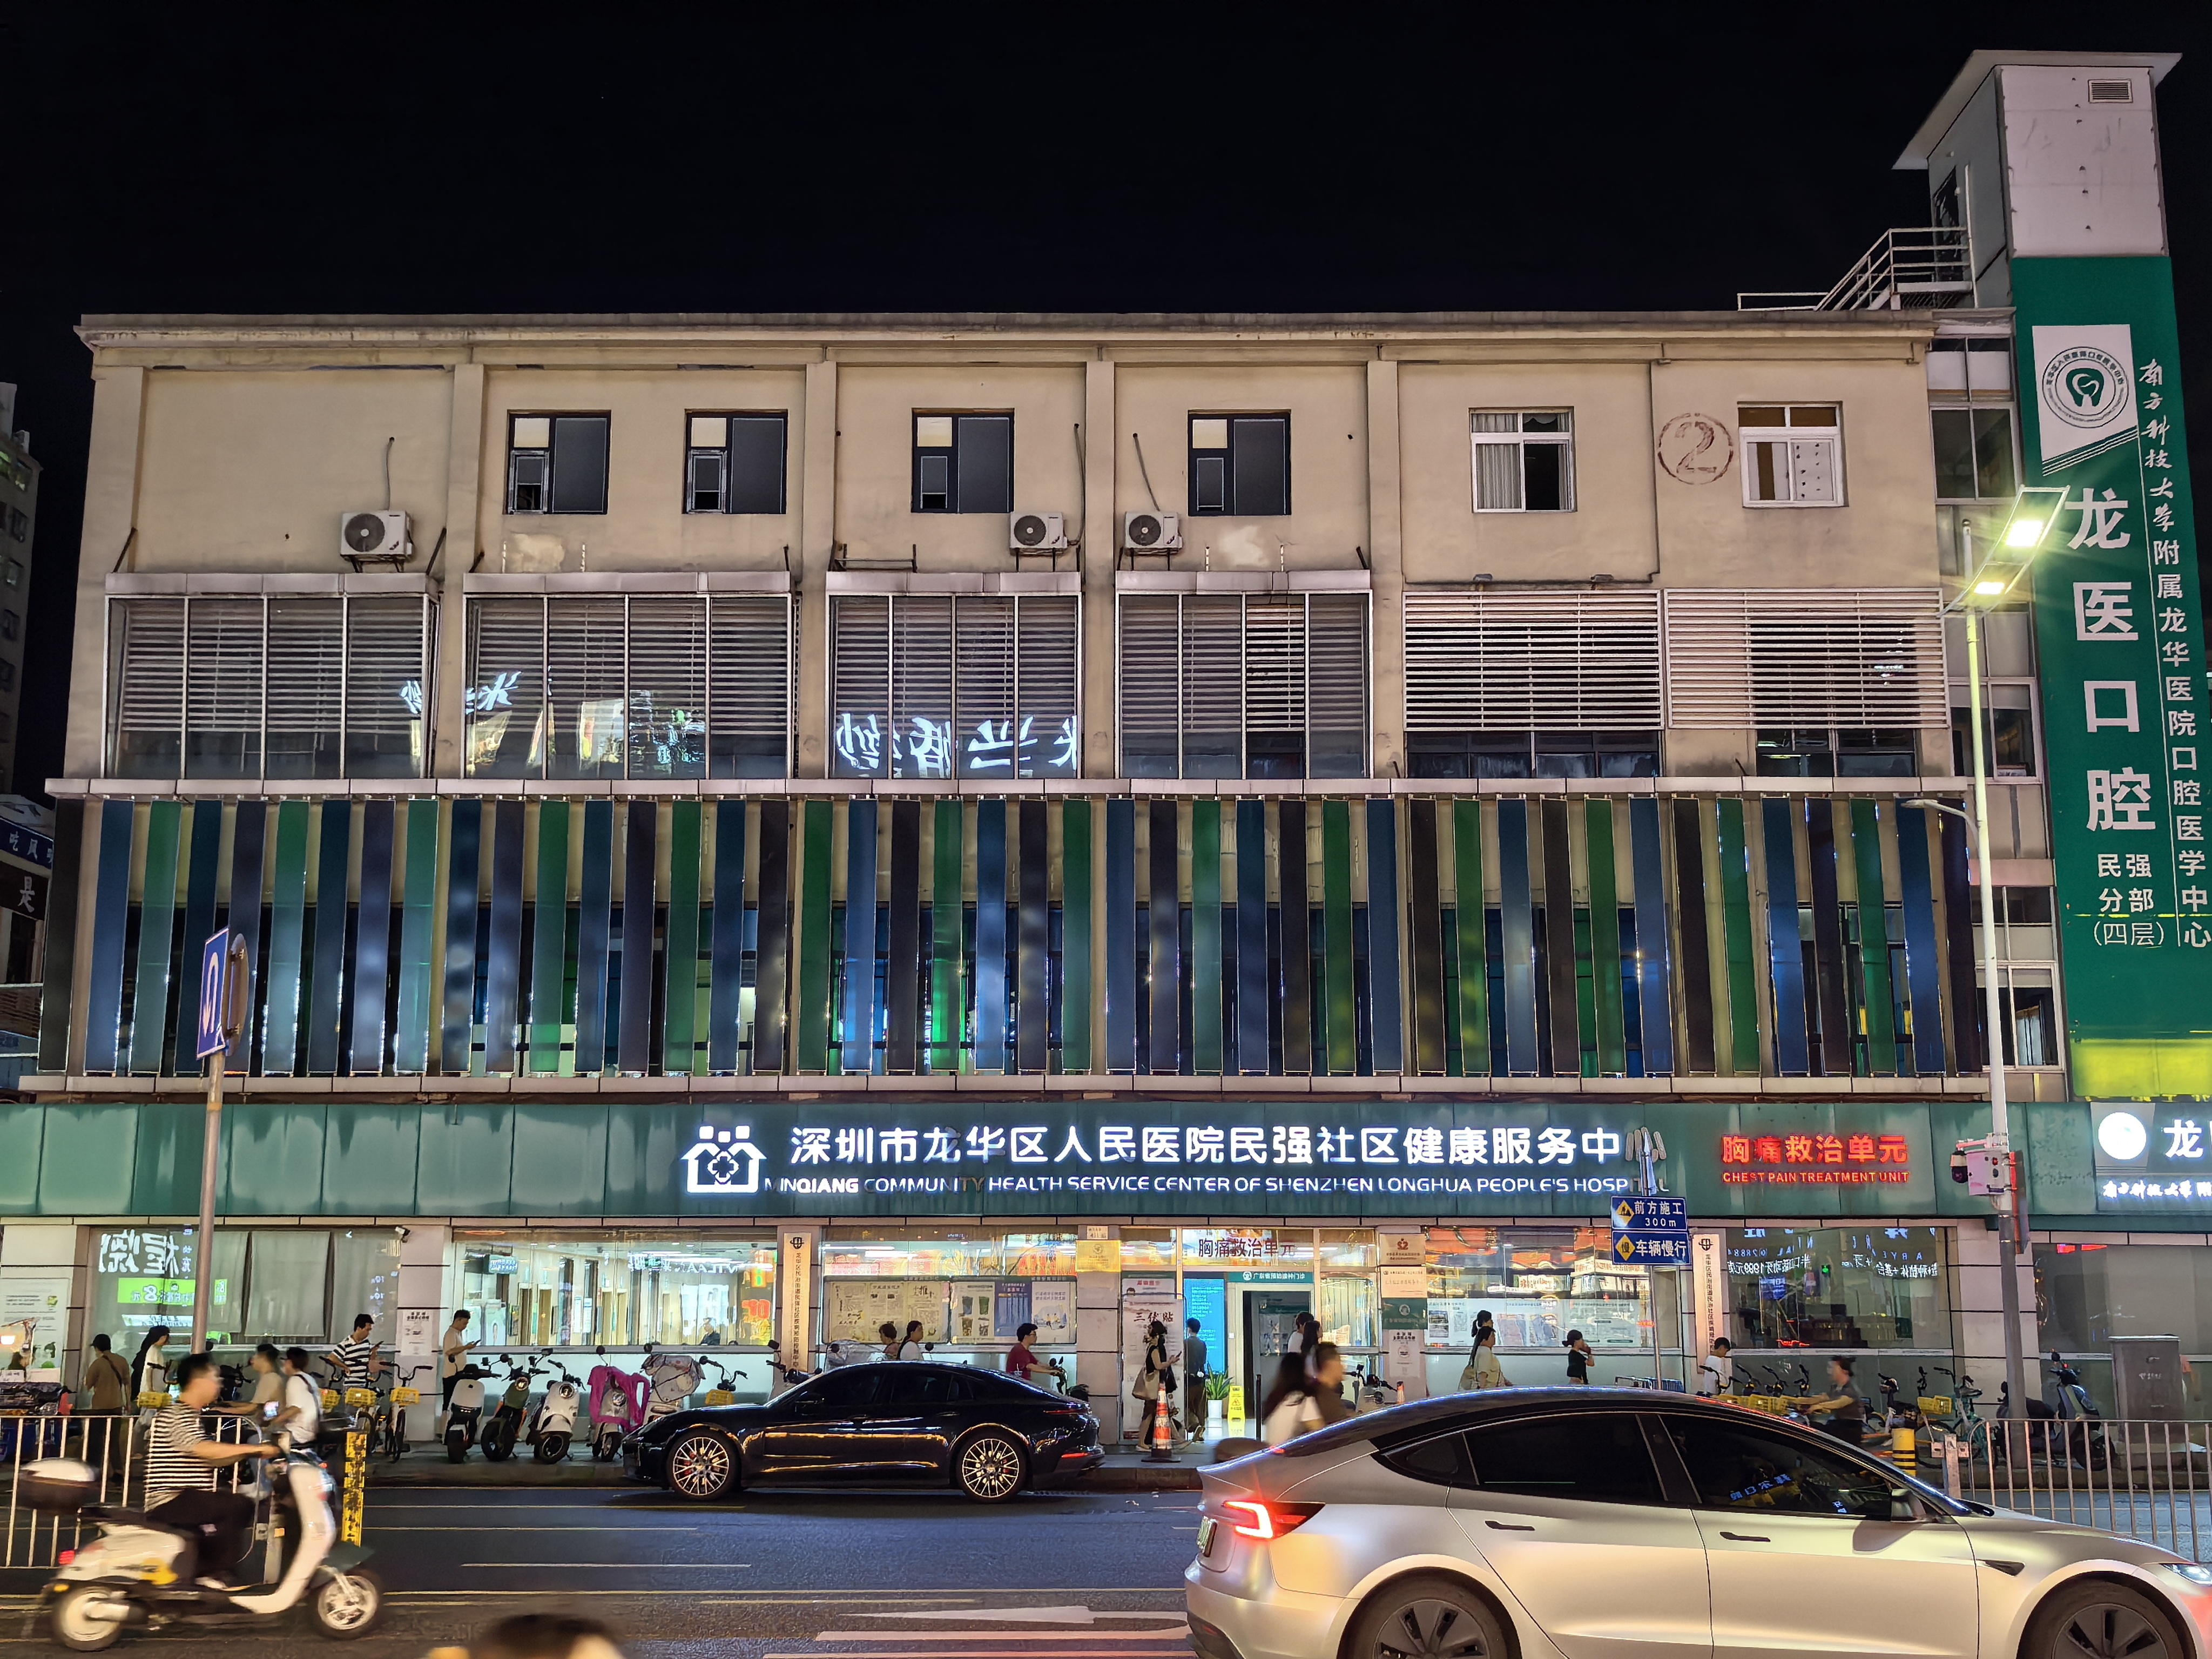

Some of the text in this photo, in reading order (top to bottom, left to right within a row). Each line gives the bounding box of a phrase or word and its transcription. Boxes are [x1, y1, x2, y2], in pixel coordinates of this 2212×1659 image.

[2065, 488, 2156, 832] 龙医口腔
[2098, 853, 2153, 879] 民强
[2099, 888, 2154, 913] 分部
[1722, 1135, 1908, 1163] 胸痛救治单元
[864, 1177, 985, 1193] COMMUNITY
[989, 1177, 1062, 1192] HEALTH
[1067, 1176, 1150, 1191] SERVICE
[1154, 1177, 1230, 1191] CENTER
[1234, 1177, 1261, 1192] OF
[1265, 1177, 1373, 1192] SHENZHEN
[1378, 1177, 1473, 1192] LONGHUA
[1476, 1178, 1568, 1192] PEOPLE'S
[1573, 1178, 1670, 1192] HOSPITL
[1723, 1171, 1910, 1183] CHEST PAIN TREATMENT UNIT
[1634, 1201, 1684, 1215] 前方施工
[1198, 1238, 1297, 1258] 胸痛救治单元
[1635, 1239, 1687, 1260] 车辆慢行
[1134, 1311, 1174, 1323] 三伏贴
